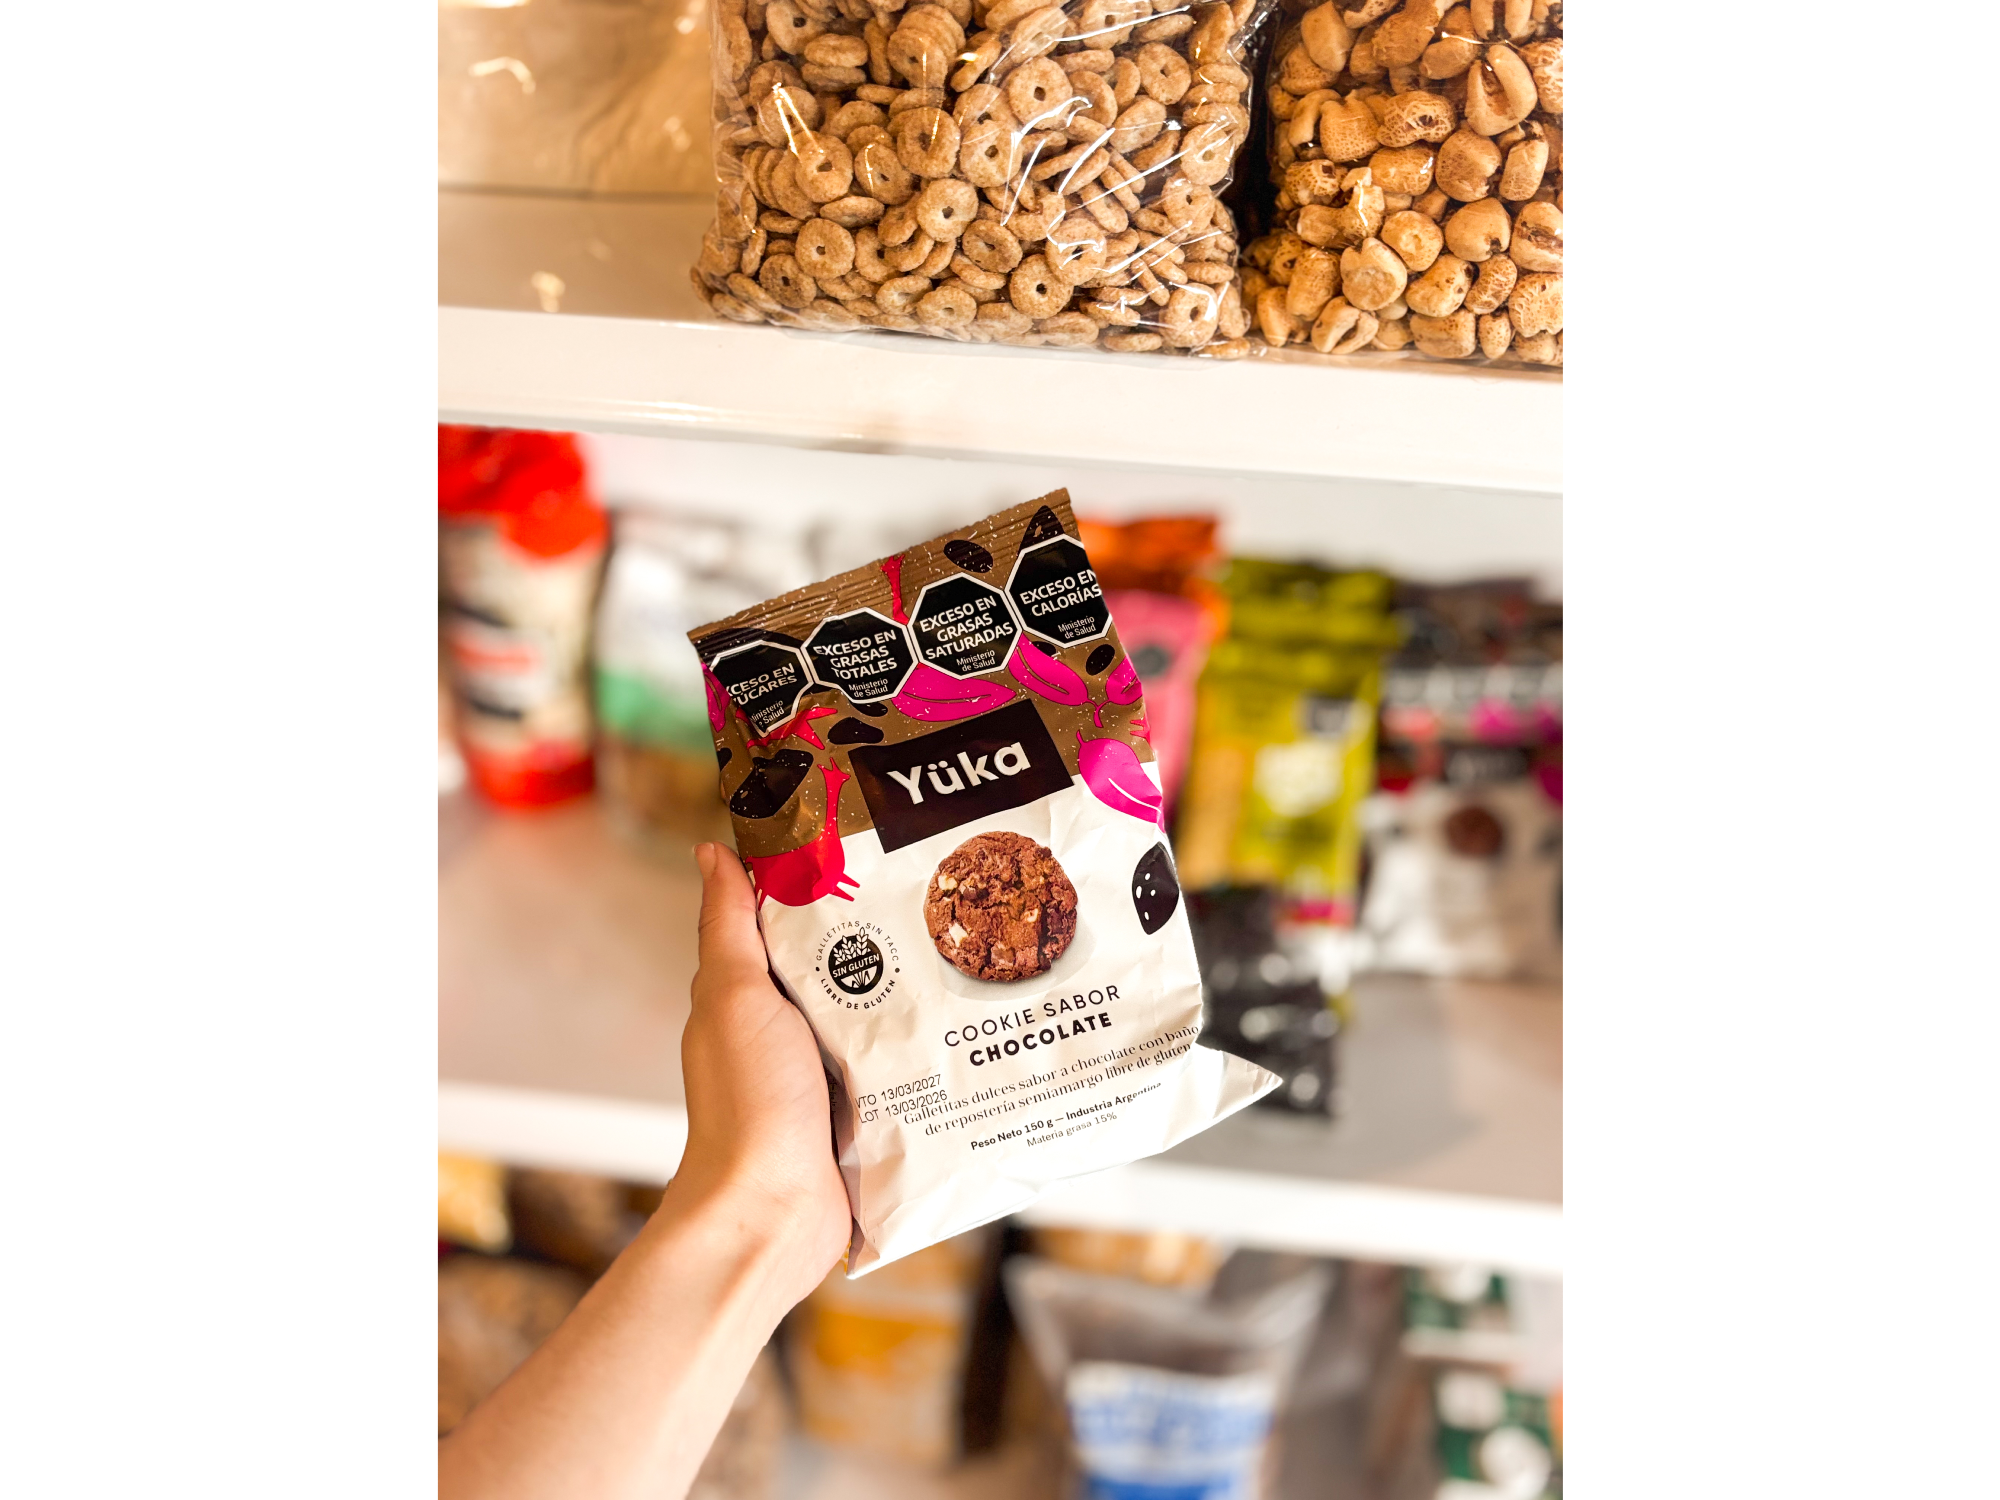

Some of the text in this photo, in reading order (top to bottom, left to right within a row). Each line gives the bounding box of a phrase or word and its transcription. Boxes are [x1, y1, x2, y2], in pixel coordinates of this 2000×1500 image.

[1020, 569, 1097, 604] EXCESO EN
[1031, 583, 1102, 616] CALORÍAS
[919, 595, 997, 632] EXCESO EN
[936, 612, 993, 642] GRASAS
[1058, 615, 1095, 632] Ministerio
[813, 629, 896, 656] EXCESO EN
[925, 621, 1014, 660] SATURADAS
[1064, 623, 1096, 639] de Salud
[830, 645, 889, 668] GRASAS
[831, 657, 897, 680] TOTALES
[956, 649, 995, 666] Ministerio
[961, 657, 995, 672] de Salud
[726, 662, 795, 696] XCESO EN
[733, 675, 798, 705] ÚCARES
[848, 678, 888, 691] Ministerio
[853, 685, 888, 698] de Salud
[762, 706, 785, 724] Salud
[886, 741, 1031, 805] Yüka
[816, 920, 899, 961] GALLETITAS SIN TACC
[832, 953, 880, 978] SIN GLUTEN
[820, 978, 896, 1010] LIBRE DE GLUTEN
[944, 985, 1120, 1047] COOKIE SABOR
[969, 1012, 1112, 1066] CHOCOLATE
[855, 1094, 877, 1109] VTO
[881, 1073, 941, 1101] 13/03/2027
[904, 1026, 1199, 1125] Galletitas dulces sabor a chocolate con baño
[925, 1043, 1191, 1136] de repostería semiamargo libre de gluten
[859, 1089, 948, 1124] LOT 13/03/2026
[970, 1137, 996, 1150] Peso
[997, 1129, 1022, 1142] Neto
[1024, 1120, 1044, 1134] 150
[1046, 1119, 1054, 1128] g
[1066, 1100, 1112, 1120] Industria
[1026, 1111, 1117, 1147] Materia grasa 15%
